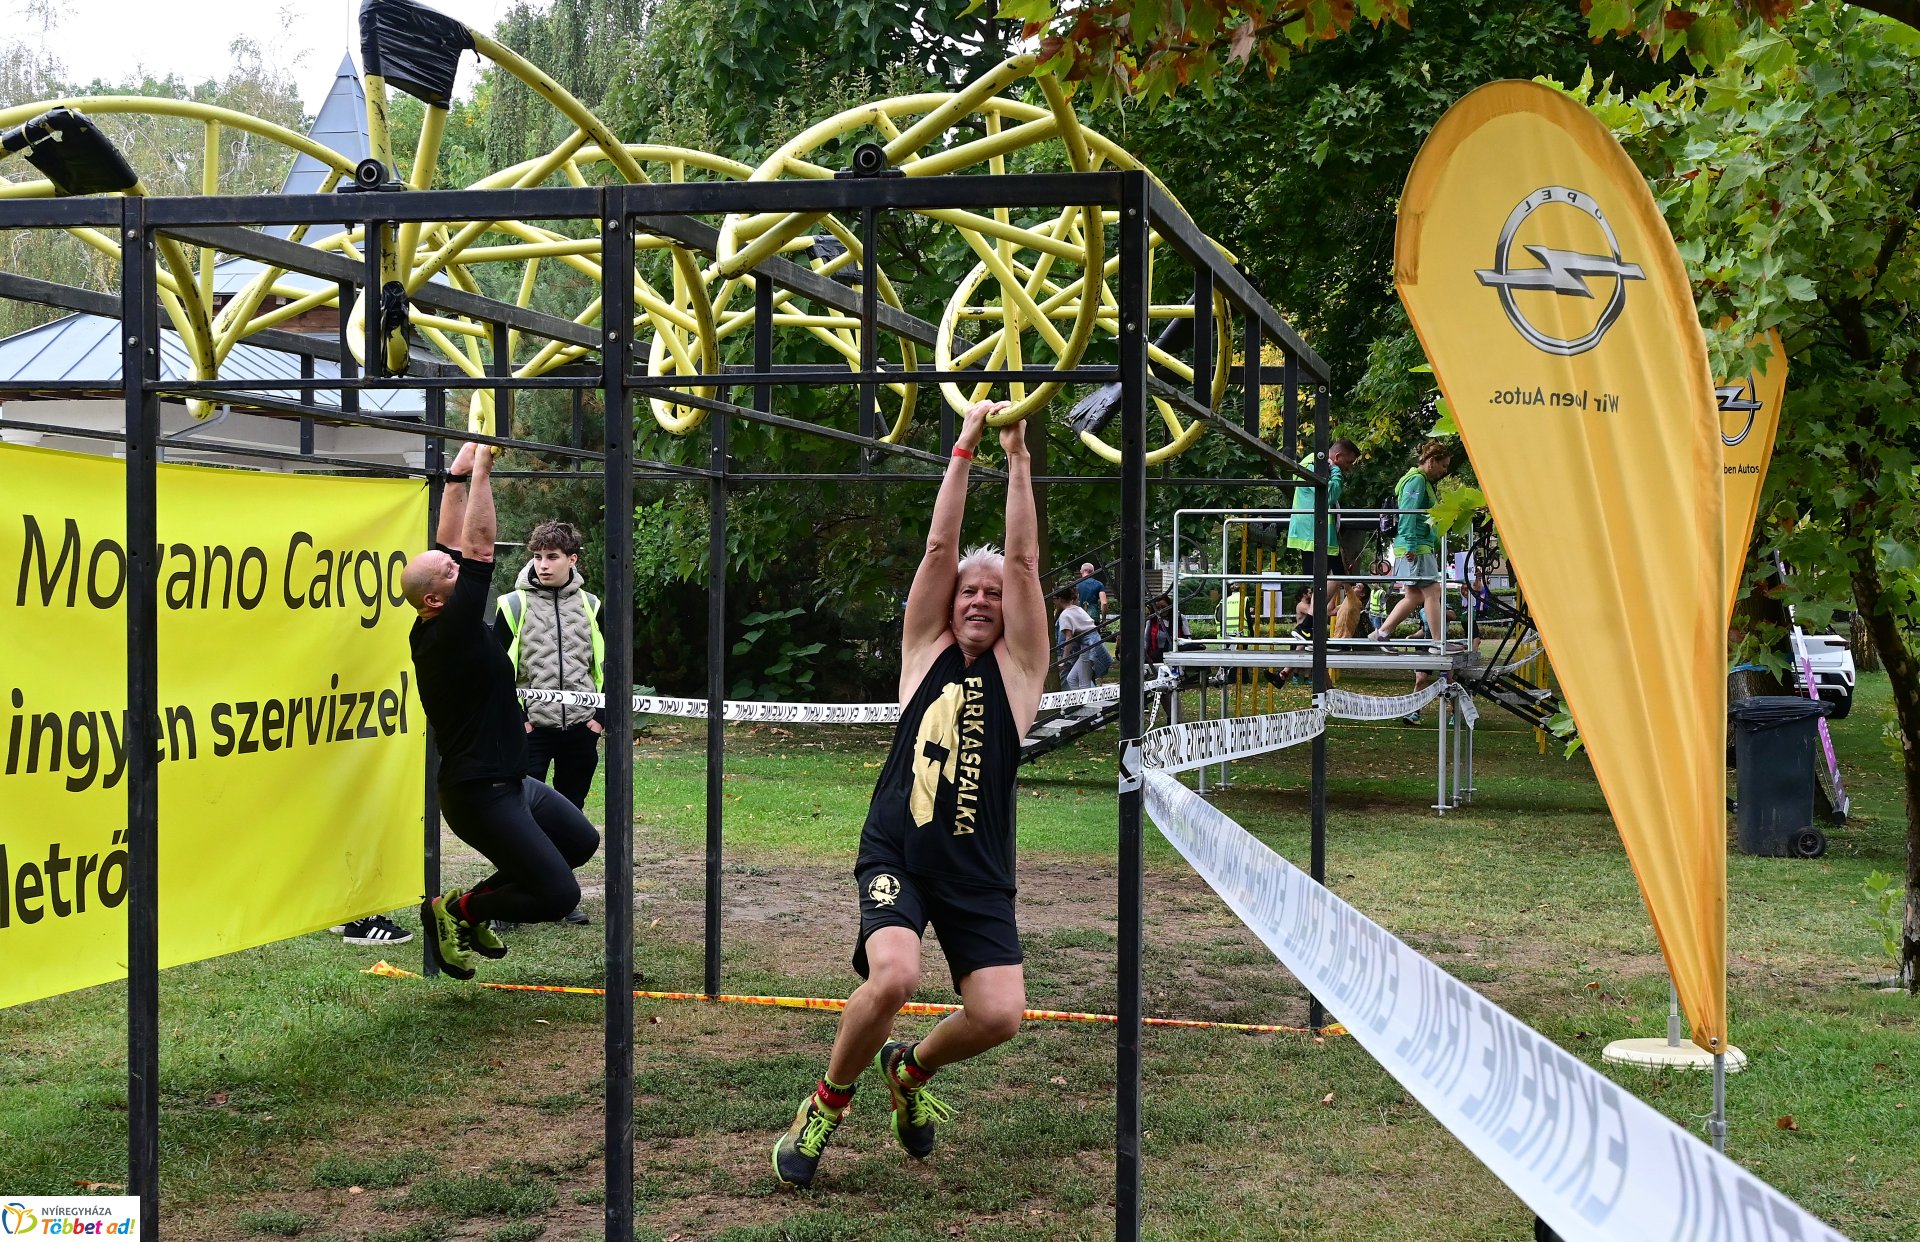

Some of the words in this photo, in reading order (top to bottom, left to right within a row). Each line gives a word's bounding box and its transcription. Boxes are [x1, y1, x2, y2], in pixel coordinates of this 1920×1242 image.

[282, 530, 408, 629] Cargo
[211, 671, 408, 757] szervizzel
[952, 676, 985, 837] FARKASFALKA
